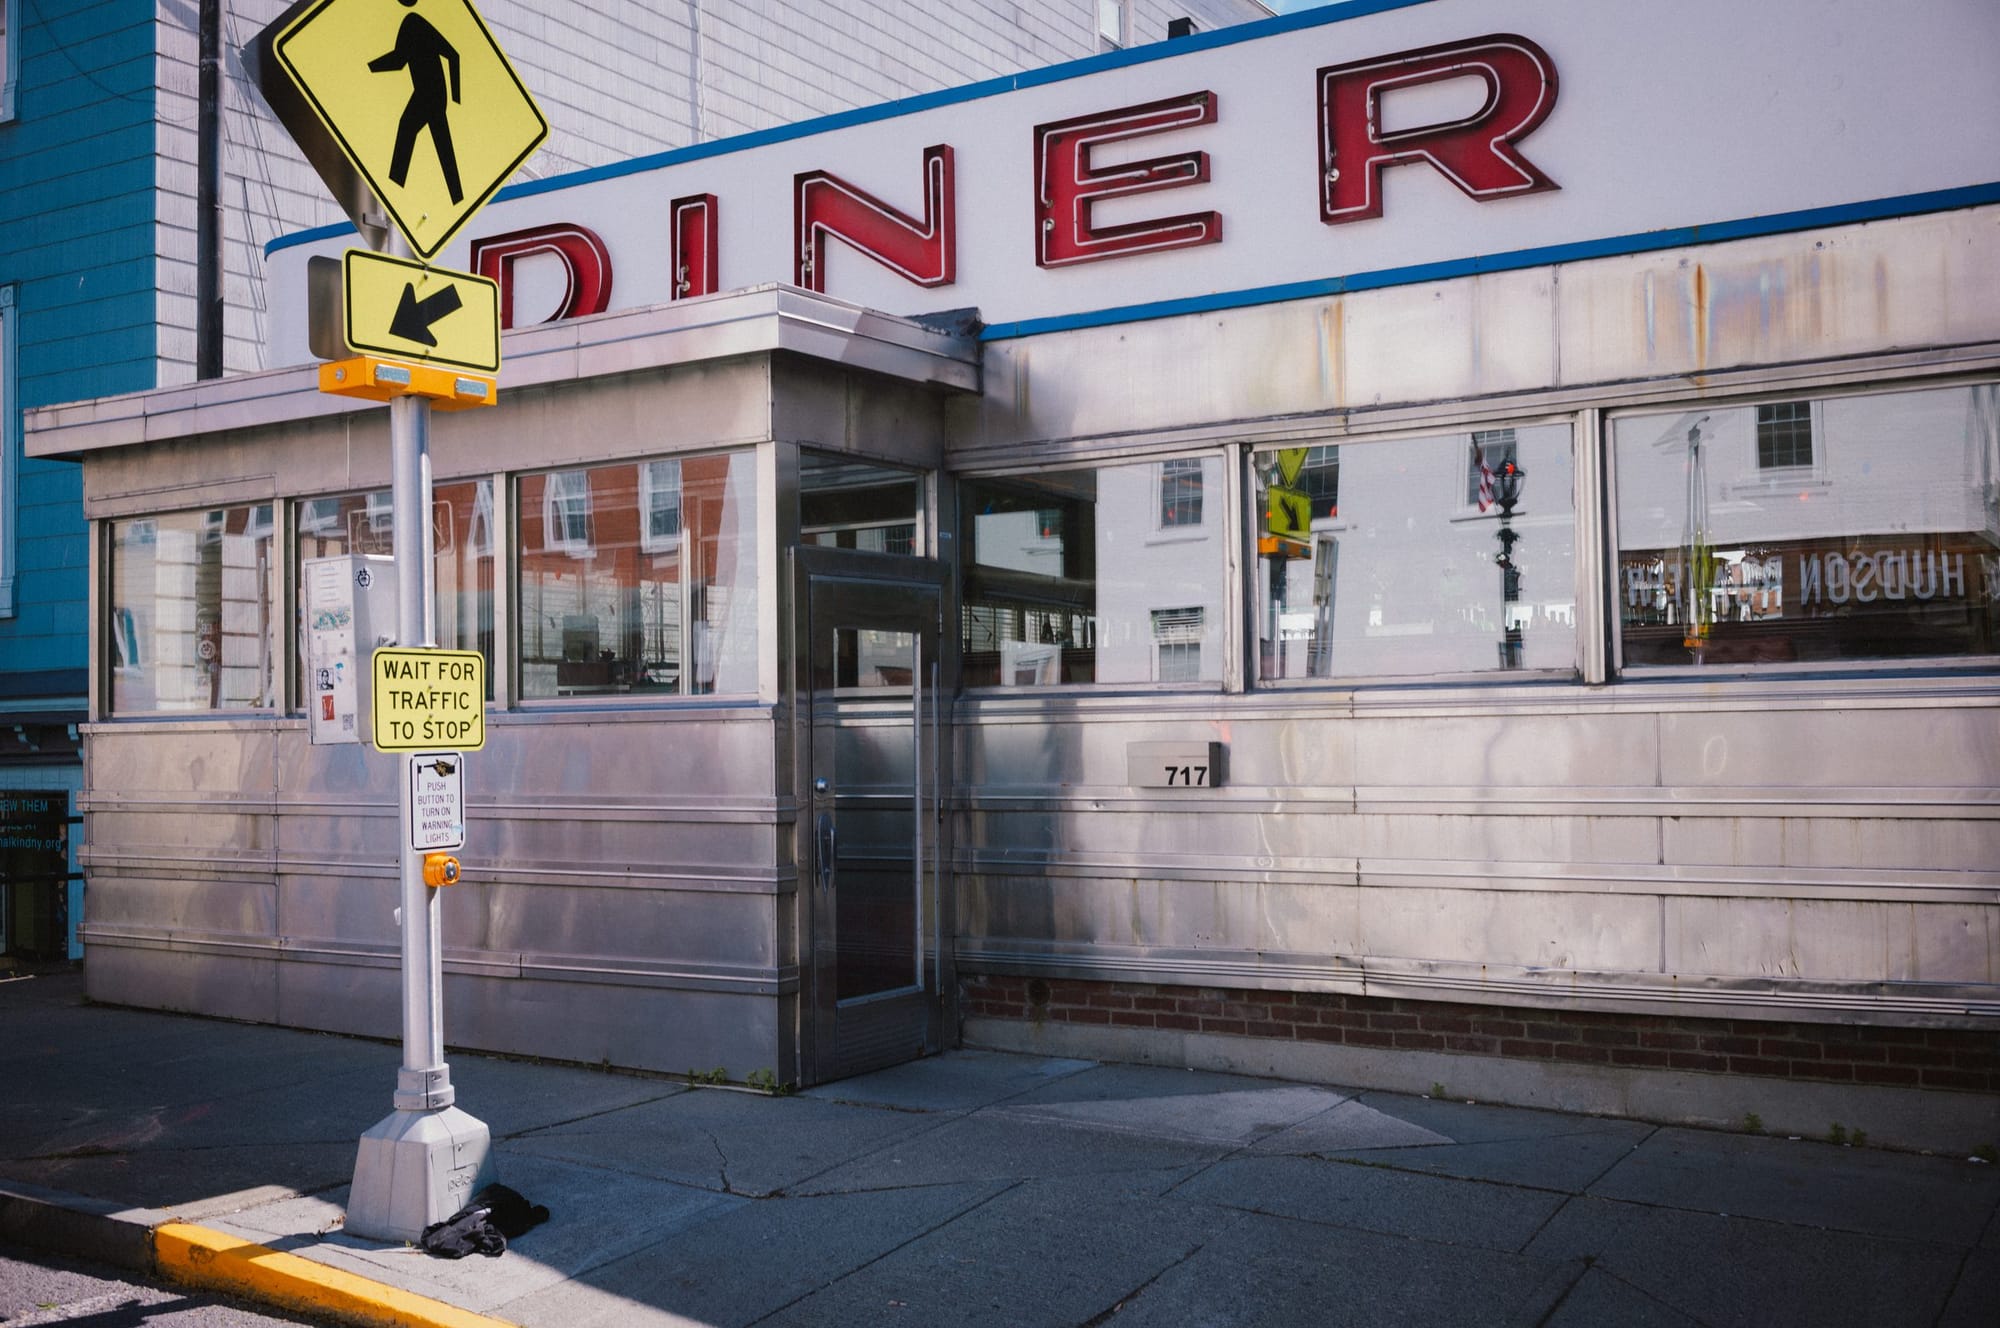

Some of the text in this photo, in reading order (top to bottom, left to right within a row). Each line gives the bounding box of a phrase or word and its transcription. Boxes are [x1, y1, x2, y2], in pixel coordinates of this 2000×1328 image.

[471, 33, 1561, 330] DINER
[383, 660, 475, 681] WAIT FOR
[388, 690, 470, 710] TRAFFIC
[389, 720, 471, 740] TO STOP
[1164, 766, 1208, 786] 717
[427, 781, 446, 792] PUSH
[22, 798, 49, 813] THEM
[417, 793, 455, 805] BUTTON TO
[422, 806, 451, 817] TURN ON
[422, 820, 453, 831] WARNING
[425, 832, 450, 844] LIGHTS
